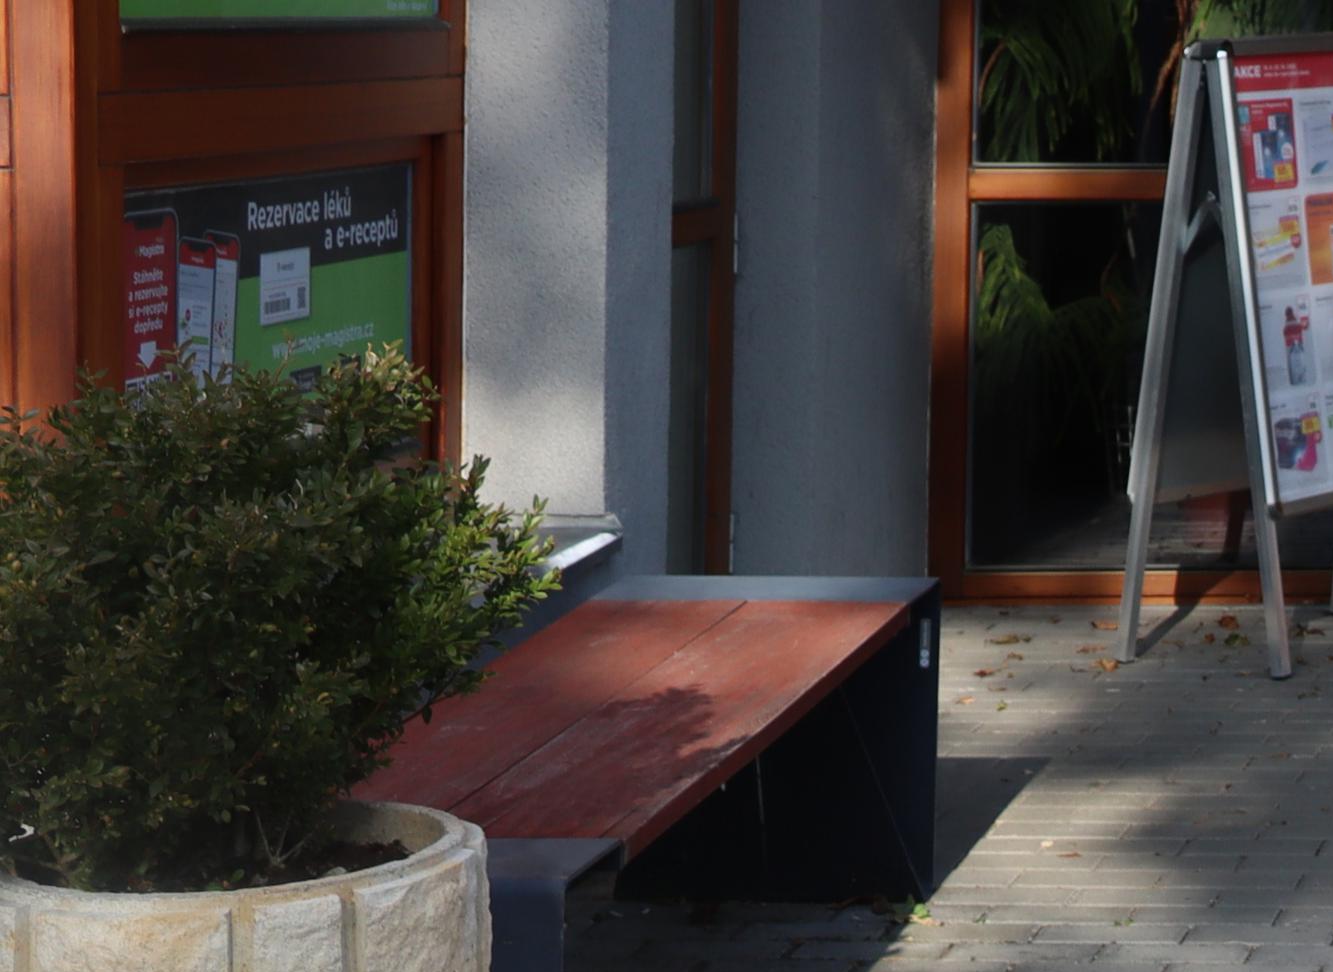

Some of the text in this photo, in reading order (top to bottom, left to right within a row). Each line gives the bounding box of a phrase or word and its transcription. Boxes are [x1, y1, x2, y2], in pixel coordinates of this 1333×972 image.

[1234, 65, 1262, 79] AKCE
[247, 186, 352, 232] Rezervace léků
[324, 208, 399, 250] a e-receptů
